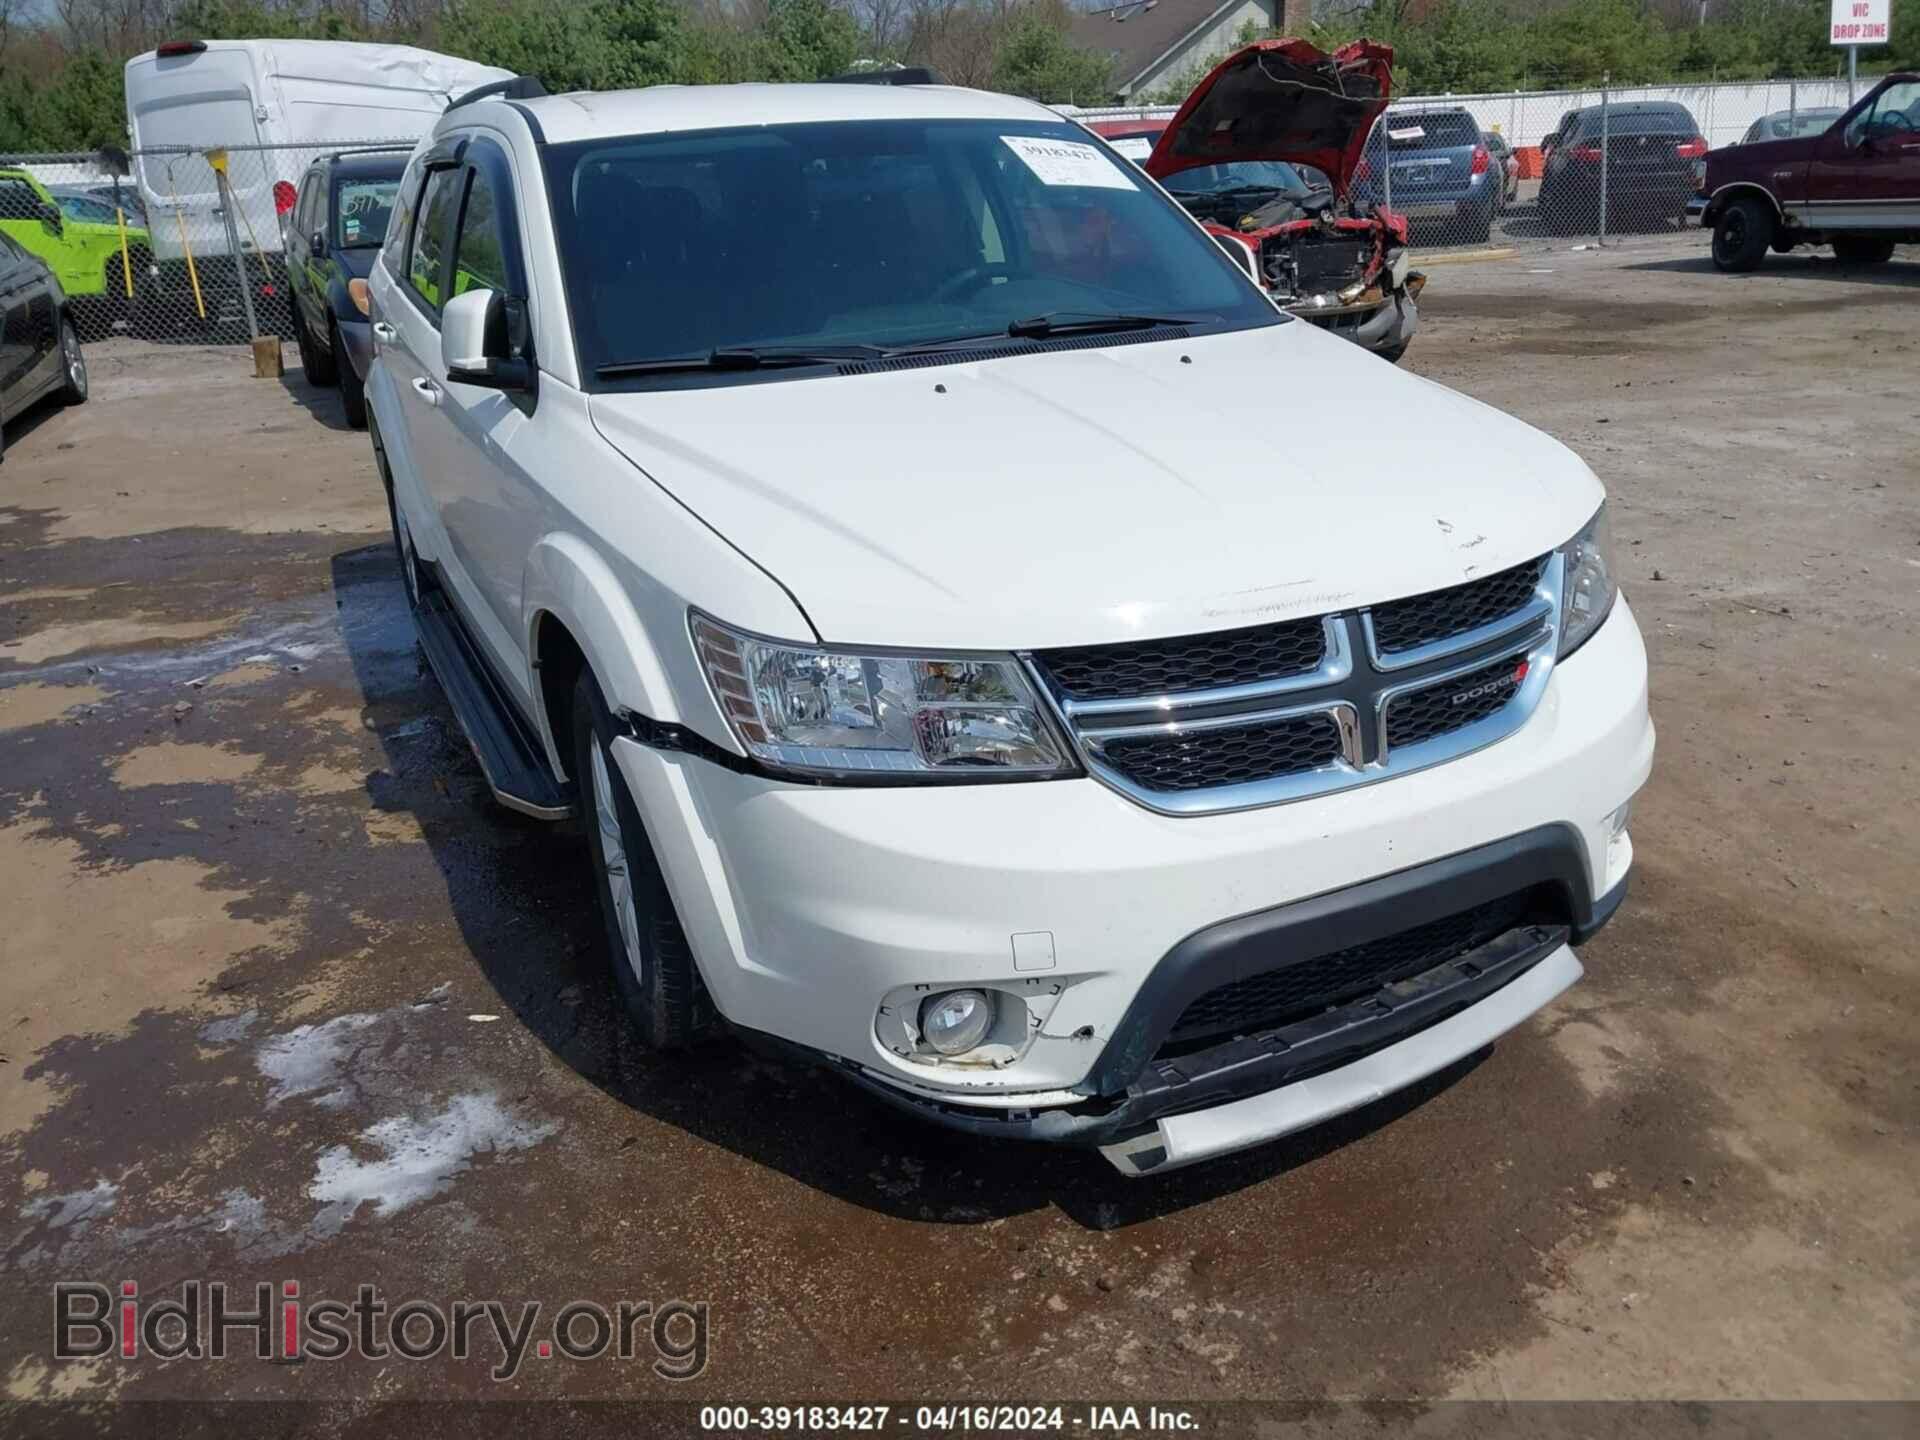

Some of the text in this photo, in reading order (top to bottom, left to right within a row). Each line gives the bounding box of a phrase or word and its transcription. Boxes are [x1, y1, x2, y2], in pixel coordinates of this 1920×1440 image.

[1852, 3, 1869, 17] VIC
[1833, 23, 1886, 39] DROP ZONE
